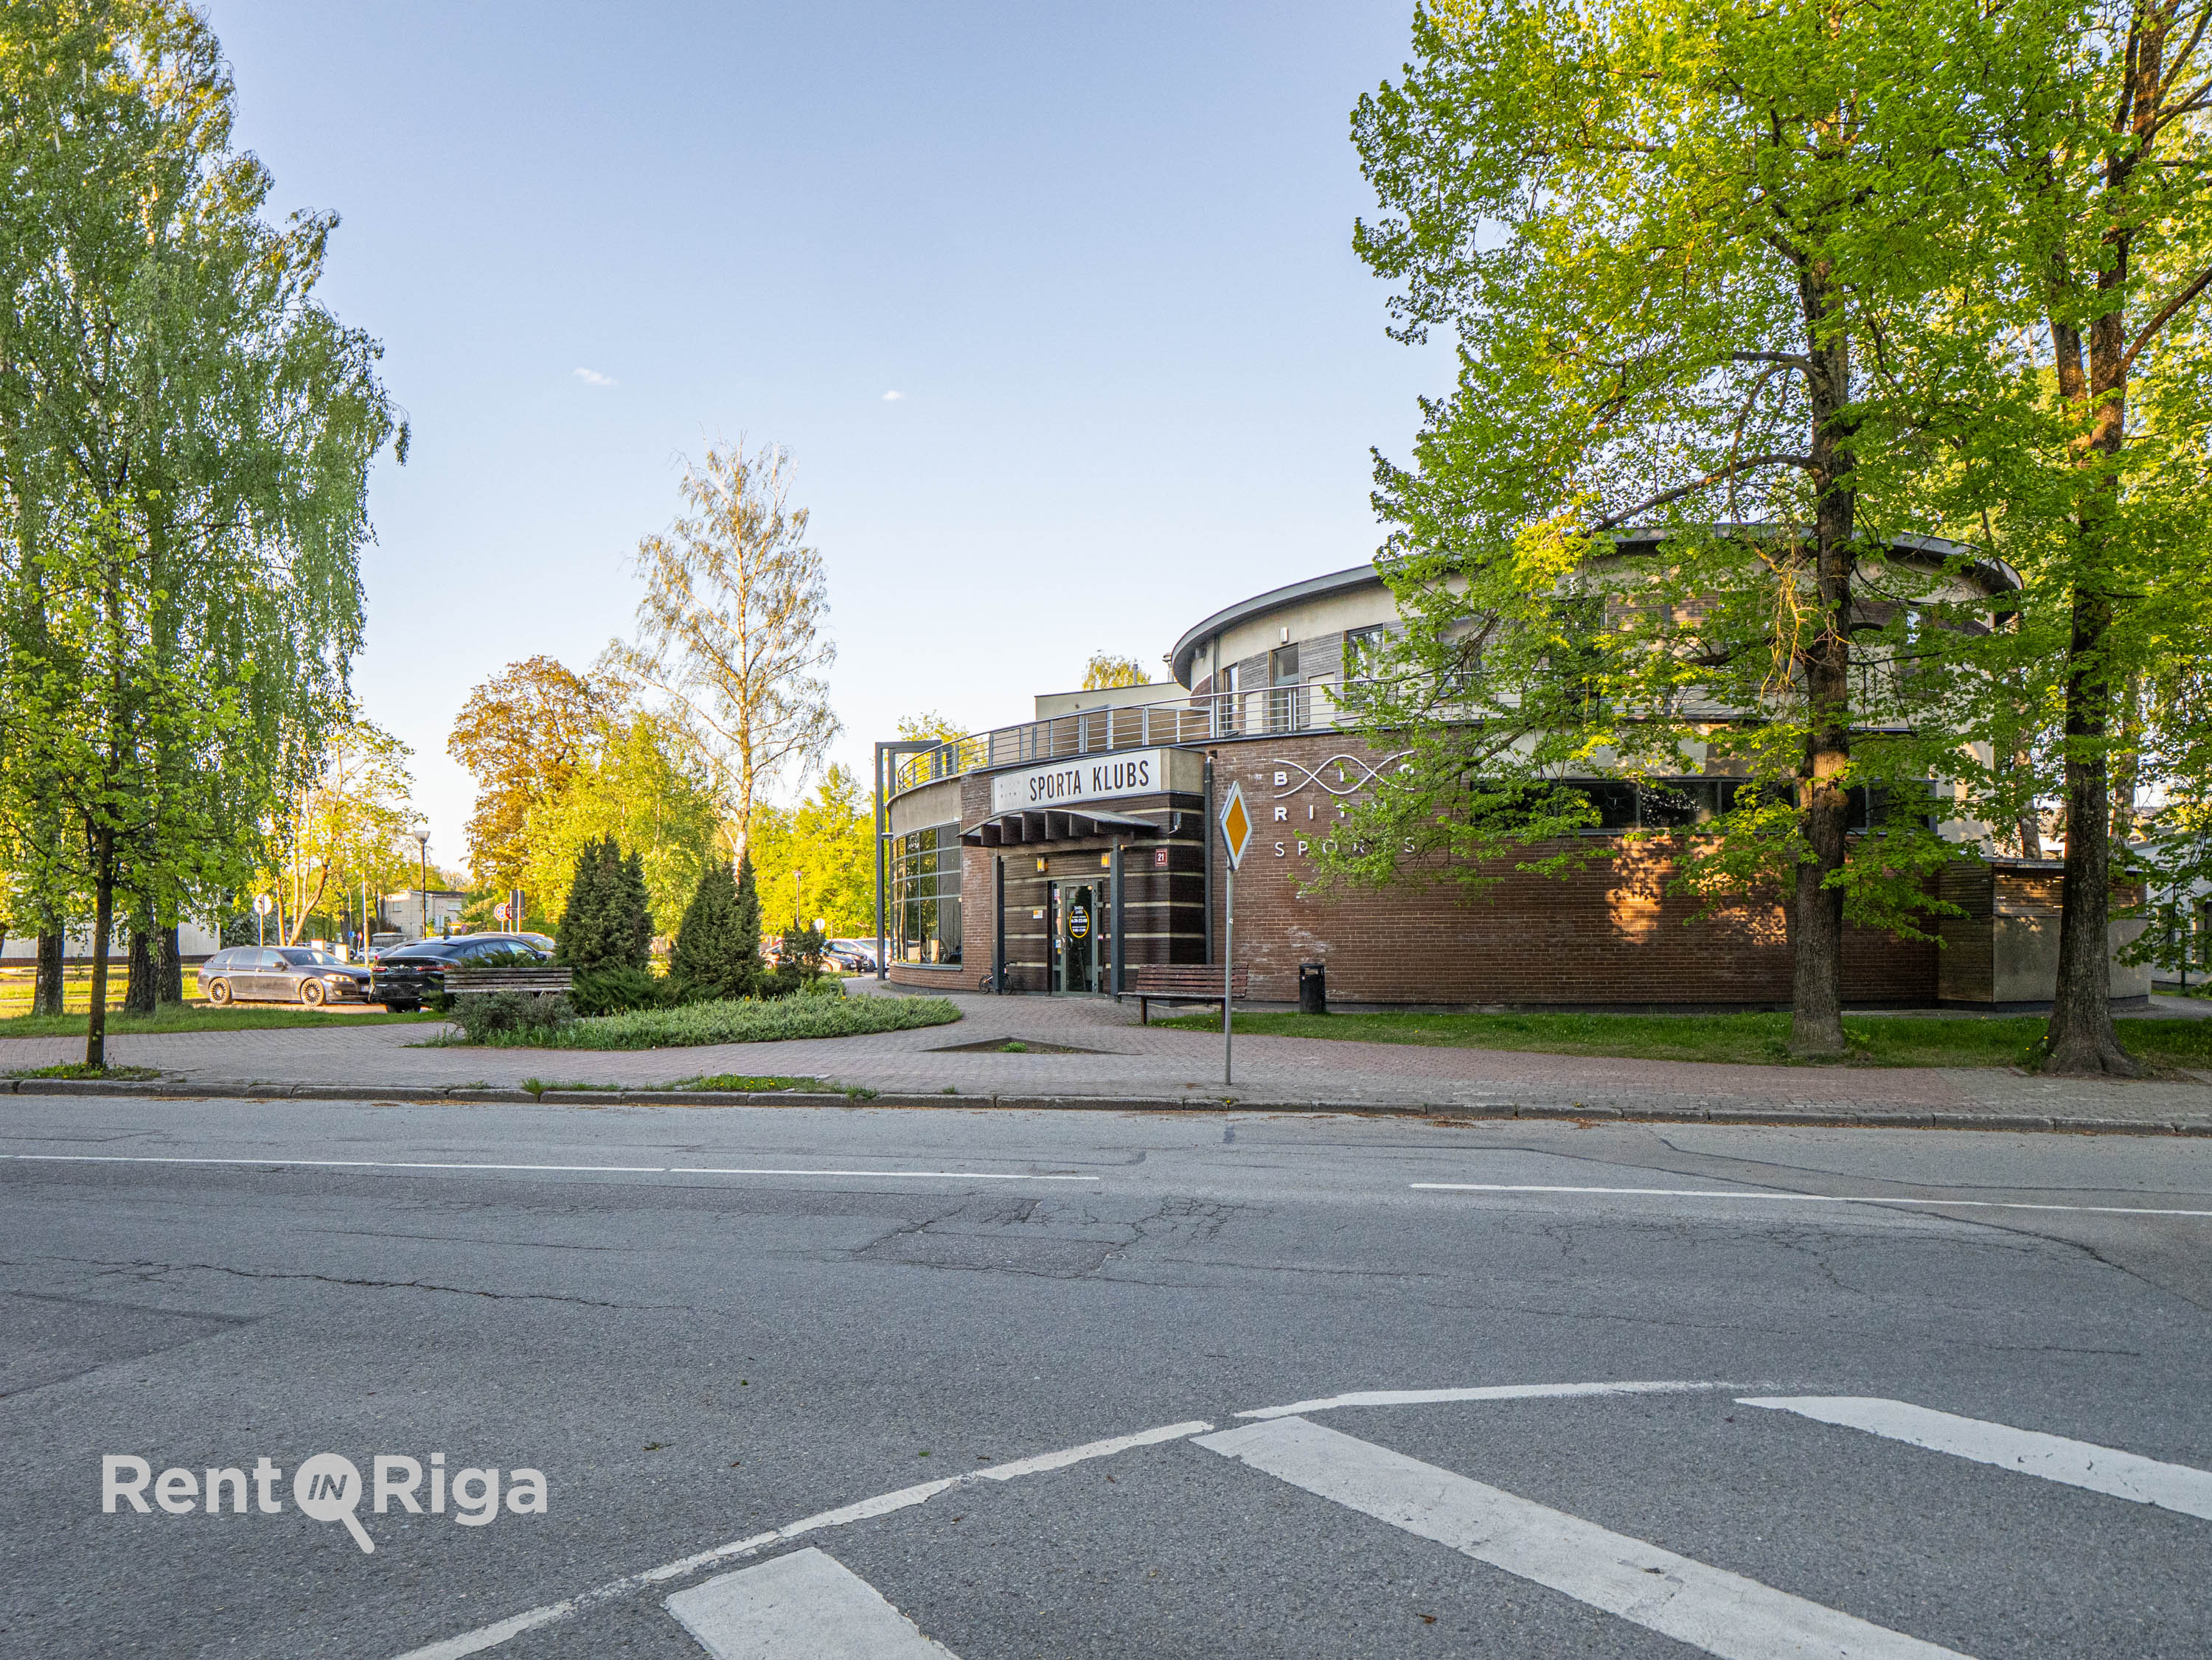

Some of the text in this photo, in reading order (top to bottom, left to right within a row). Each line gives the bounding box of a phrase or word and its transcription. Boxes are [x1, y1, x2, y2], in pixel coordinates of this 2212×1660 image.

[1029, 770, 1082, 801] SPORTA
[1093, 760, 1150, 792] KLUBS
[1158, 853, 1164, 861] 21
